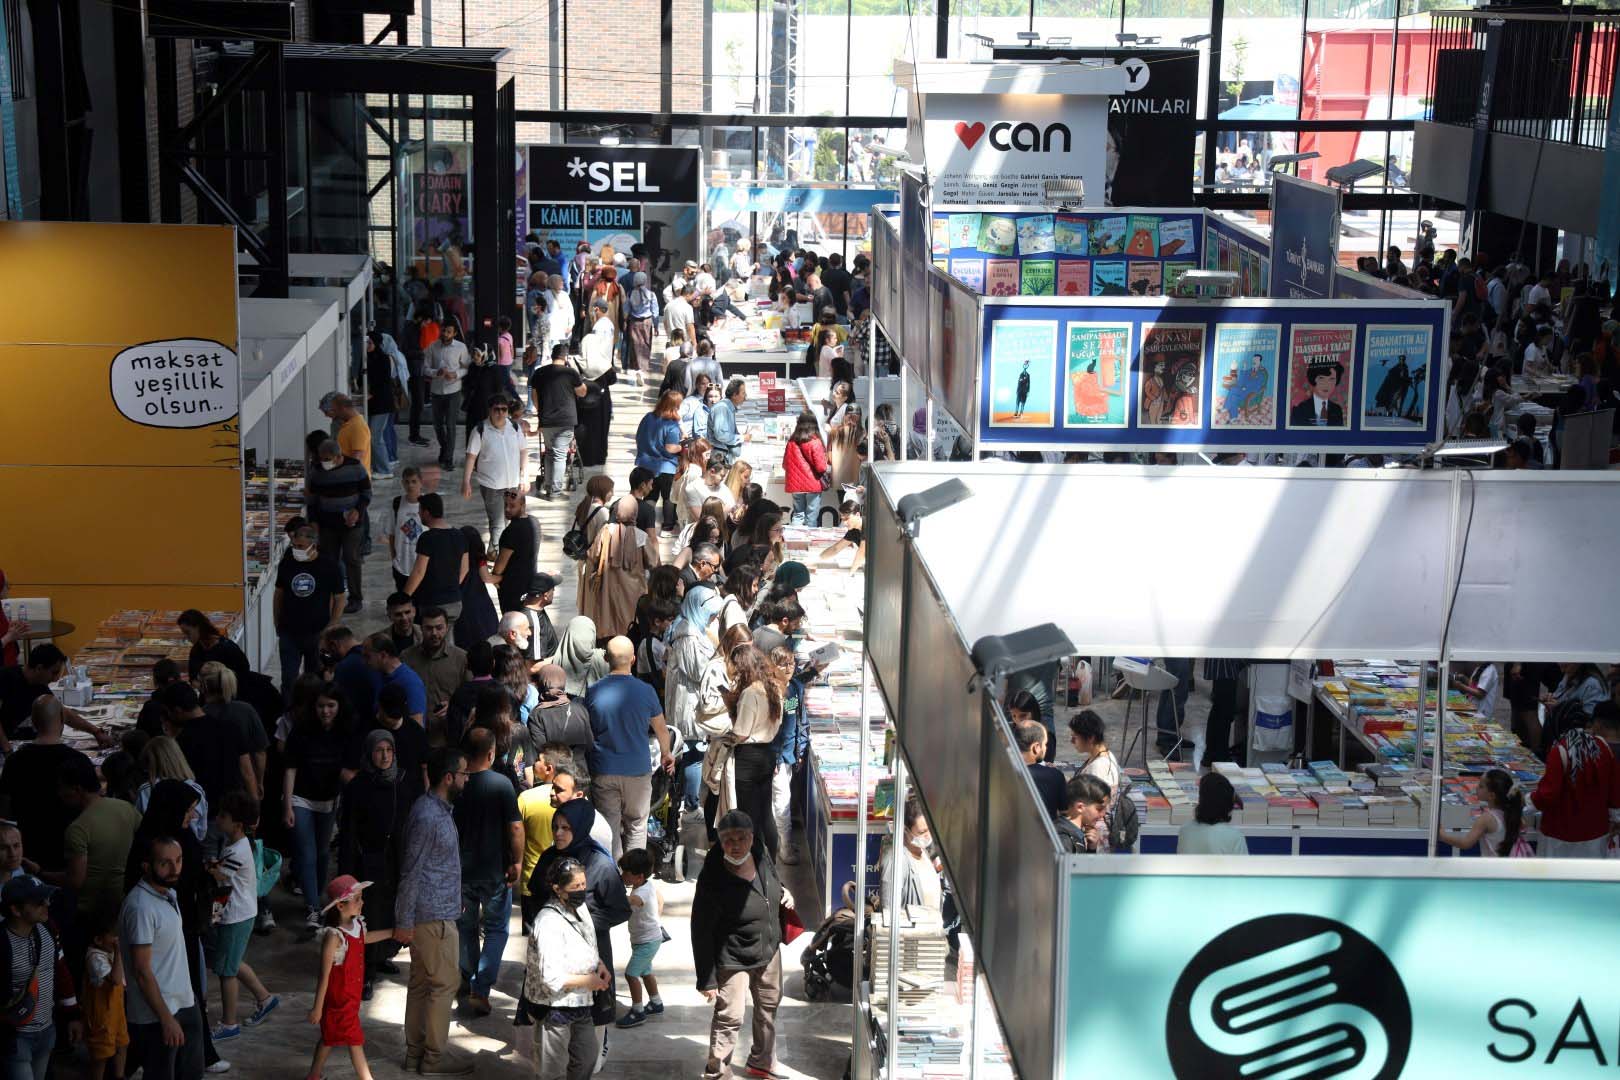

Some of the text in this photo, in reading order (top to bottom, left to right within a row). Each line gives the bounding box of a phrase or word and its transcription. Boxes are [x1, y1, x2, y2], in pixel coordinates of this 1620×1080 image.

[1108, 98, 1190, 114] AYINLARI
[988, 122, 1072, 152] can
[541, 204, 583, 226] KÂMİL
[588, 208, 633, 226] ERDEM
[131, 350, 223, 370] maksat
[134, 370, 224, 397] yeşillik
[1486, 996, 1620, 1067] SA
